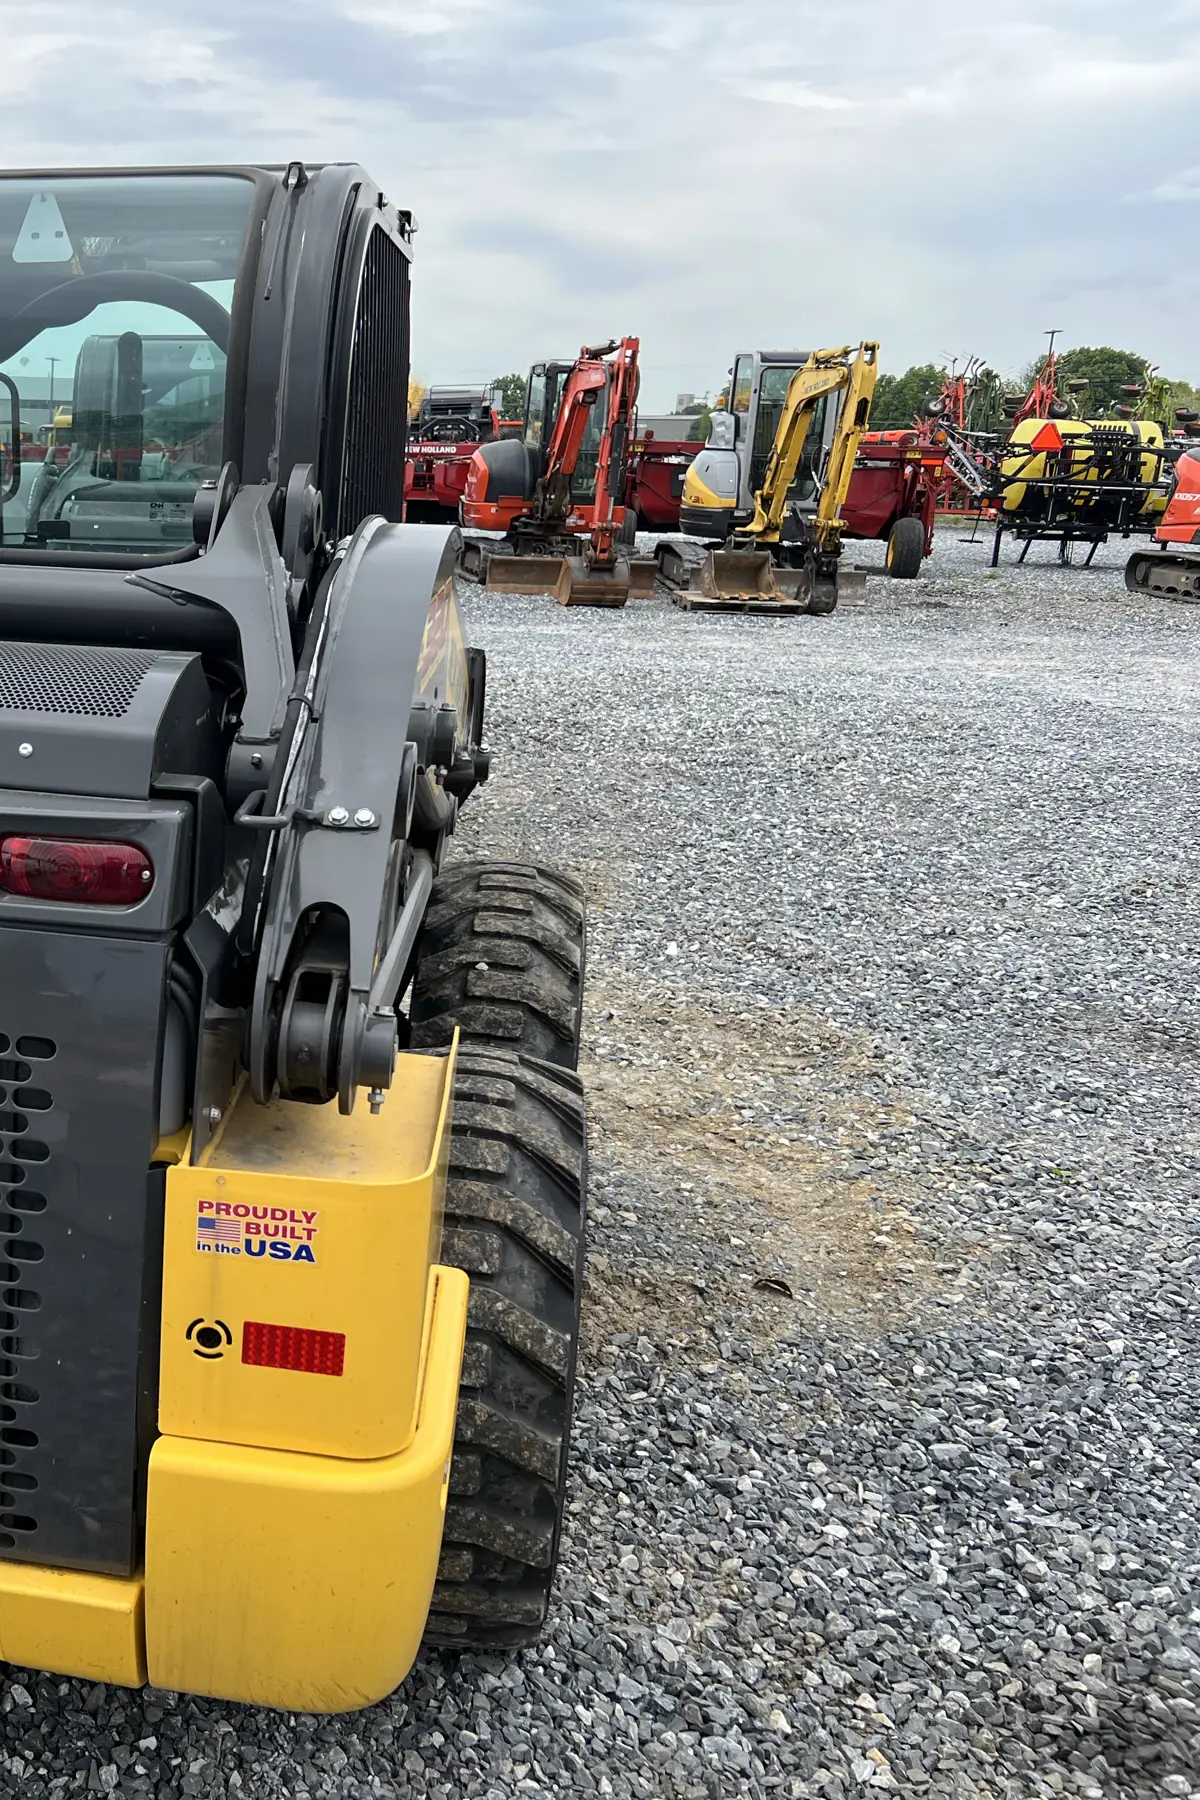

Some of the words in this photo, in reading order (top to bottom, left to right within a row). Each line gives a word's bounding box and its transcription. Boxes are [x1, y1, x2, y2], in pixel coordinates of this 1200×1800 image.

[421, 446, 457, 454] HOLLAND
[198, 1200, 317, 1224] PROUDLY
[244, 1221, 318, 1241] BUILT
[197, 1241, 212, 1251] in
[215, 1243, 241, 1255] the
[244, 1238, 316, 1263] USA
